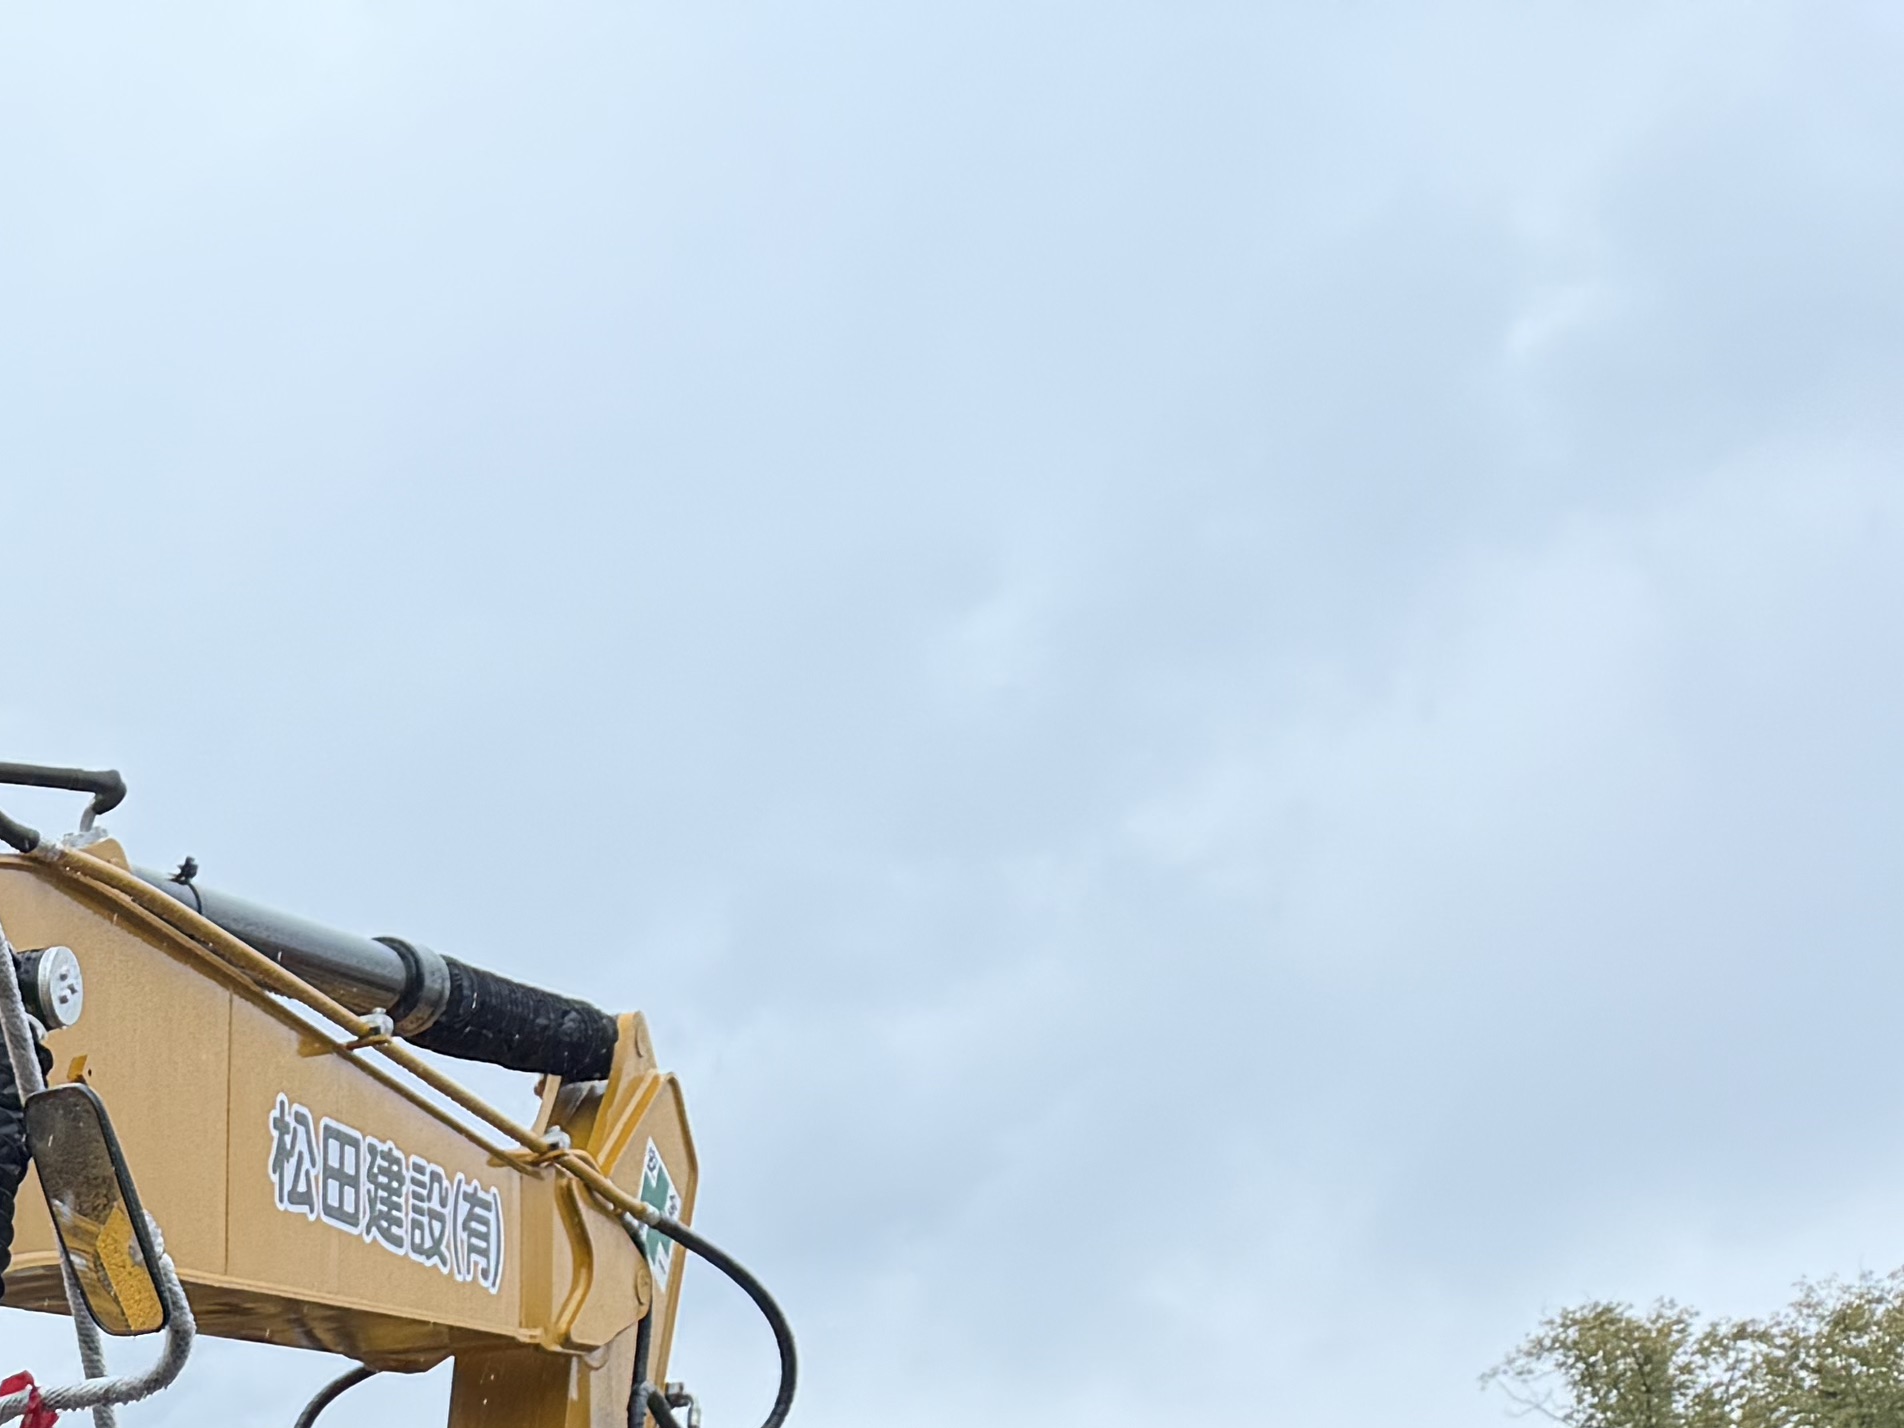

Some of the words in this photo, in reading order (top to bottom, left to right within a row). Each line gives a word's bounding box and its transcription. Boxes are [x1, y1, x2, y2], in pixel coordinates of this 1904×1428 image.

[270, 1093, 503, 1293] 松田建設(有)
